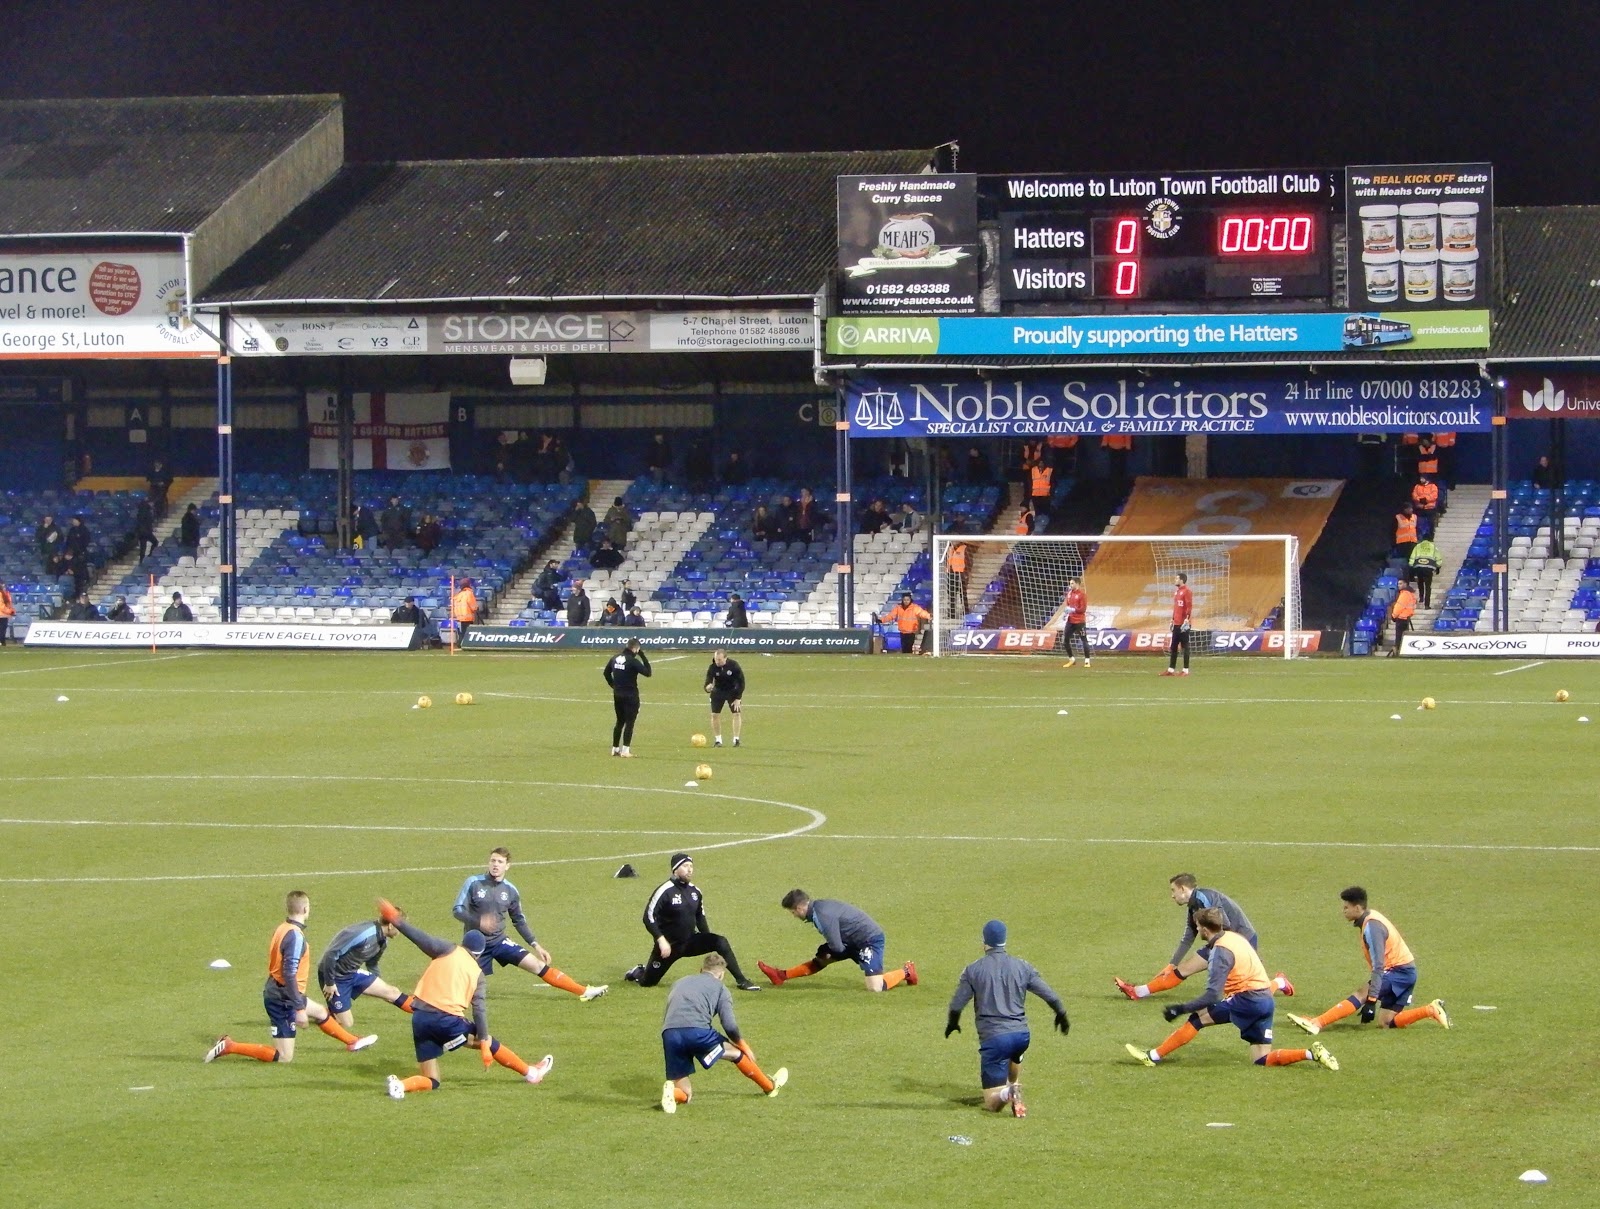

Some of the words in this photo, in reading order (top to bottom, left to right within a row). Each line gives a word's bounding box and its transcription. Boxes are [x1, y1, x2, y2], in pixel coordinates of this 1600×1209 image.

[858, 182, 897, 192] Freshly
[899, 181, 956, 191] Handmade
[1008, 180, 1084, 198] Welcome
[1089, 179, 1105, 197] to
[1110, 178, 1156, 197] Luton
[1160, 177, 1206, 195] Town
[1211, 175, 1277, 194] Football
[1282, 174, 1320, 193] Club
[1352, 177, 1370, 185] The
[1373, 176, 1401, 184] REAL
[1404, 175, 1431, 184] KICK
[1434, 174, 1455, 183] OFF
[1457, 174, 1488, 183] starts
[1355, 188, 1377, 197] with
[1379, 187, 1412, 196] Meahs
[1414, 187, 1442, 196] Curry
[1444, 185, 1485, 195] Sauces!
[872, 194, 901, 204] Curry
[903, 194, 942, 203] Sauces
[1145, 198, 1163, 212] LUTON
[1164, 198, 1180, 211] TOWN
[1014, 228, 1085, 249] Hatters
[1115, 220, 1137, 254] 0
[1145, 224, 1169, 239] FOOTBALL
[1168, 224, 1181, 237] CLUB
[1222, 218, 1311, 252] 00:00
[883, 230, 930, 249] MEAH'S
[0, 267, 77, 293] ance
[1013, 268, 1086, 289] Visitors
[1116, 261, 1137, 294] 0
[155, 278, 180, 300] LUTON
[866, 284, 903, 294] 01582
[905, 283, 950, 294] 493388
[843, 295, 974, 307] www.curry-sauces.co.uk
[26, 305, 36, 319] &
[42, 305, 86, 319] more!
[302, 322, 326, 331] BOSS
[444, 314, 603, 341] STORAGE
[683, 316, 698, 326] 5-7
[701, 316, 736, 327] Chapel
[739, 316, 772, 326] Street,
[778, 316, 808, 325] Luton
[156, 324, 189, 345] FOOTBALL
[691, 328, 737, 338] Telephone
[739, 327, 766, 335] 01582
[768, 327, 800, 335] 488086
[863, 328, 933, 344] ARRIVA
[1013, 326, 1083, 348] Proudly
[1087, 325, 1189, 347] supporting
[1193, 324, 1225, 342] the
[1229, 325, 1298, 342] Hatters
[1417, 325, 1484, 335] arrivabus.co.uk
[2, 332, 56, 350] George
[62, 332, 80, 349] St,
[84, 332, 124, 346] Luton
[445, 344, 514, 353] MENSWEAR
[521, 344, 527, 352] &
[534, 344, 566, 352] SHOE
[572, 343, 608, 351] DEPT.
[677, 336, 814, 347] info@storageclothing.co.uk
[1284, 382, 1299, 400] 24
[1304, 381, 1322, 400] hr
[1326, 380, 1353, 400] line
[1360, 380, 1413, 400] 07000
[1419, 379, 1481, 399] 818283
[910, 380, 1051, 422] Noble
[1062, 379, 1268, 420] Solicitors
[130, 408, 142, 421] A
[458, 407, 467, 422] B
[799, 403, 813, 422] C
[1285, 404, 1481, 426] www.noblesolicitors.co.uk
[927, 422, 1010, 434] SPECIALIST
[1014, 421, 1096, 433] CRIMINAL
[1101, 420, 1115, 432] &
[1118, 420, 1177, 432] FAMILY
[1180, 419, 1255, 431] PRACTICE
[33, 630, 83, 639] STEVEN
[84, 631, 132, 640] EAGELL
[135, 630, 182, 639] TOYOTA
[225, 631, 275, 640] STEVEN
[276, 631, 325, 641] EAGELL
[329, 633, 377, 642] TOYOTA
[468, 631, 556, 643] ThamesLink
[581, 635, 613, 644] Luton
[617, 636, 629, 644] to
[633, 635, 675, 645] ondon
[678, 636, 689, 644] in
[691, 636, 706, 644] 33
[708, 636, 756, 645] minutes
[800, 636, 823, 646] fast
[825, 637, 860, 646] trains
[952, 630, 996, 649] sky
[1004, 633, 1050, 647] BET
[1086, 630, 1126, 649] sky
[1215, 632, 1259, 650] sky
[1442, 640, 1527, 650] SSANGYONG
